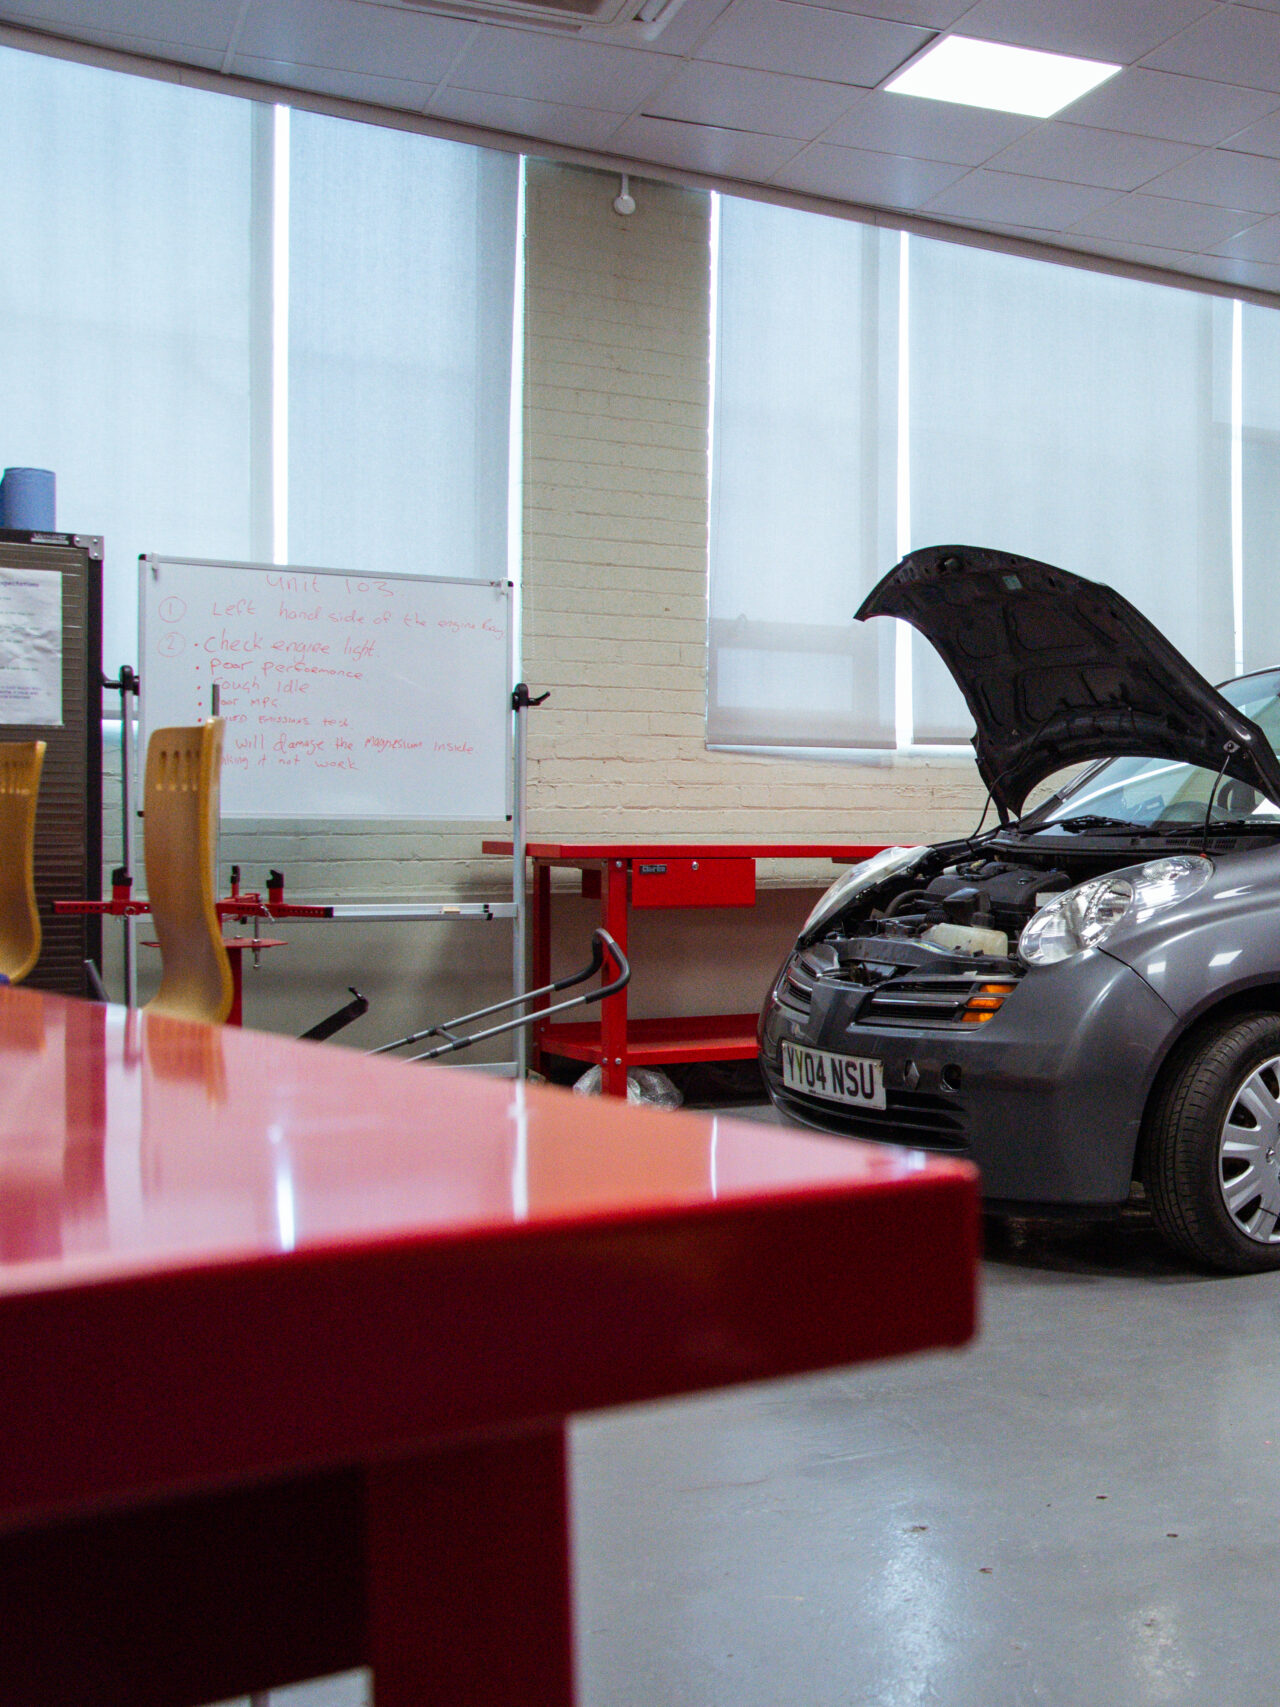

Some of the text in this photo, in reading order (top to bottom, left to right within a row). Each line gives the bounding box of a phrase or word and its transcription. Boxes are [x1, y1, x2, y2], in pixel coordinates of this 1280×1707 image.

[345, 578, 394, 597] 103
[279, 600, 322, 622] hand
[786, 1045, 875, 1100] YY04 NSU
